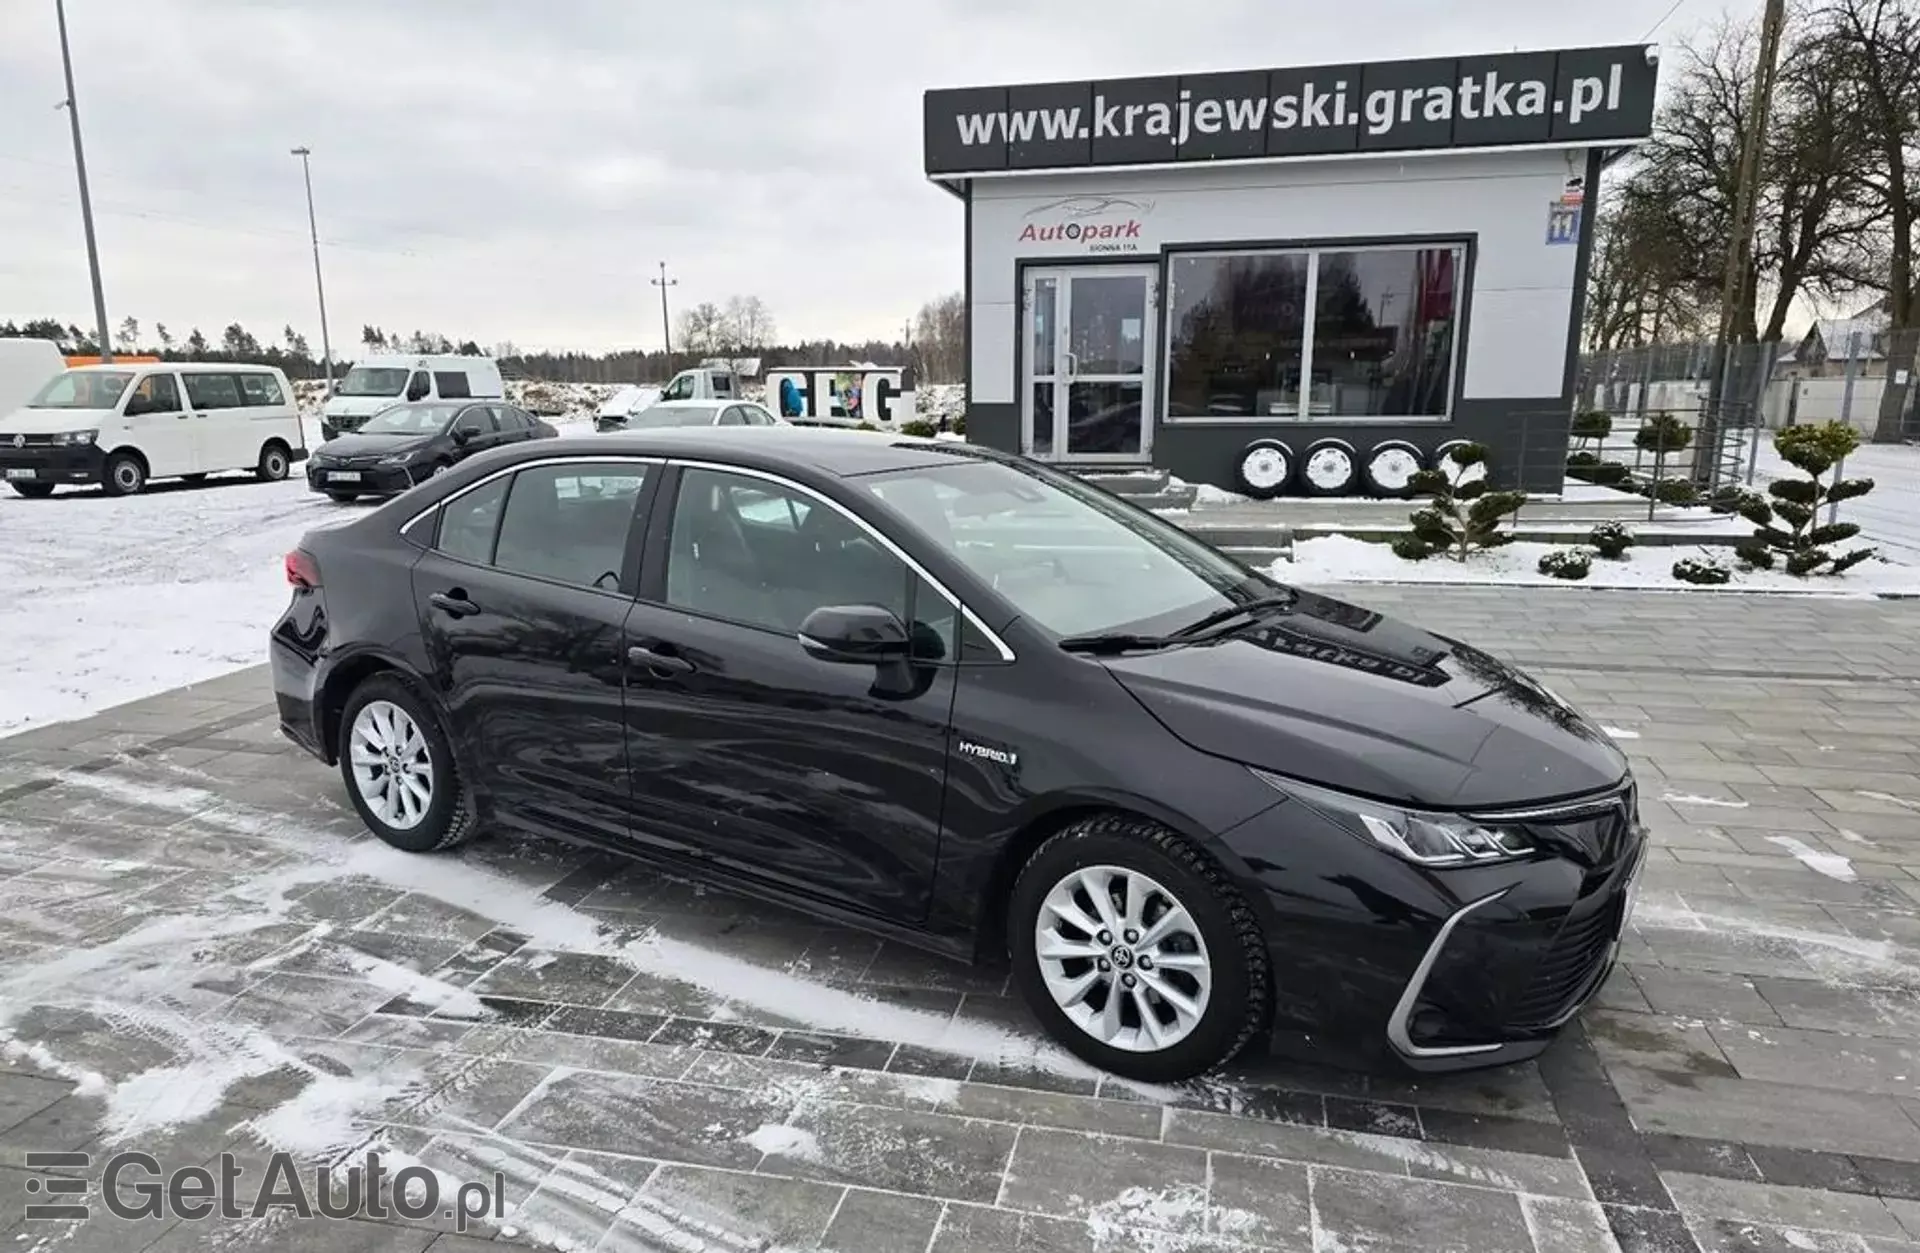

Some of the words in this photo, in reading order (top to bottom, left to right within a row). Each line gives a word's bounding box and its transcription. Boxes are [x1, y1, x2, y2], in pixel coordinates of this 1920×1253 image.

[957, 65, 1622, 146] www.krajewski.gratka.pl
[1019, 221, 1142, 243] Autopark
[959, 741, 1008, 763] HYBRID
